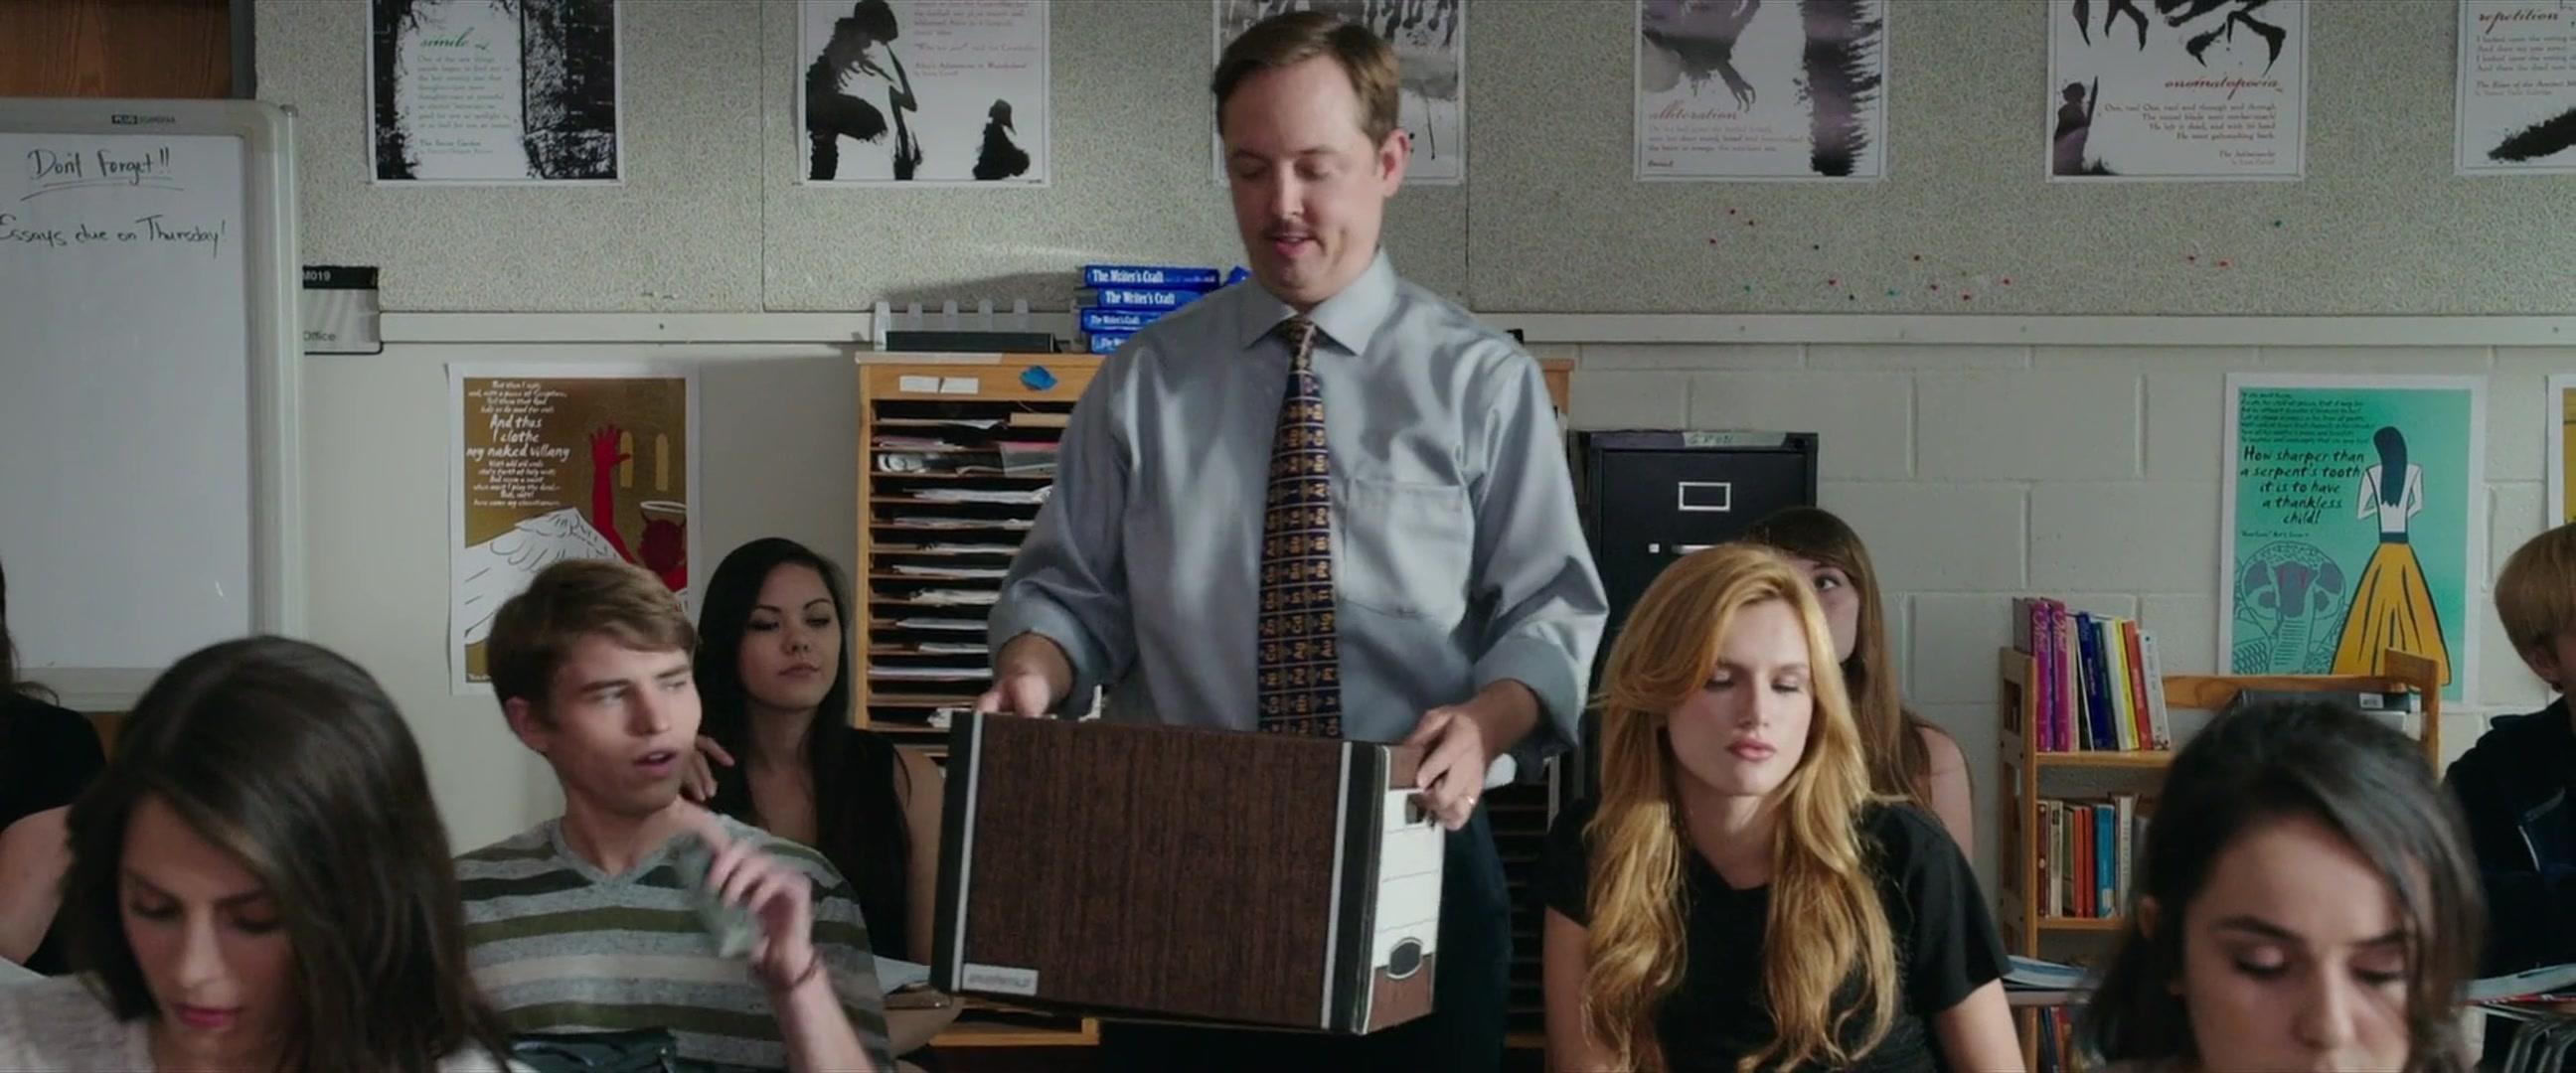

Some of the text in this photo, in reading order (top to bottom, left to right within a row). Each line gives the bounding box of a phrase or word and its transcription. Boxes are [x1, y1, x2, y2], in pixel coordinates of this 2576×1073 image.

[0, 213, 226, 259] Essays due on Thursday!
[1092, 269, 1165, 283] The Writer's Craft
[1105, 290, 1175, 305] The Writer's Craft
[1090, 315, 1102, 324] The
[490, 413, 543, 429] And thus
[493, 429, 540, 443] I clothe
[466, 447, 484, 461] my
[487, 443, 528, 457] naked
[2244, 446, 2364, 464] How sharper than
[2240, 464, 2361, 479] a serpent's tooth
[2260, 481, 2340, 495] it is to have
[2262, 495, 2342, 510] a thankless
[2283, 509, 2322, 525] child!
